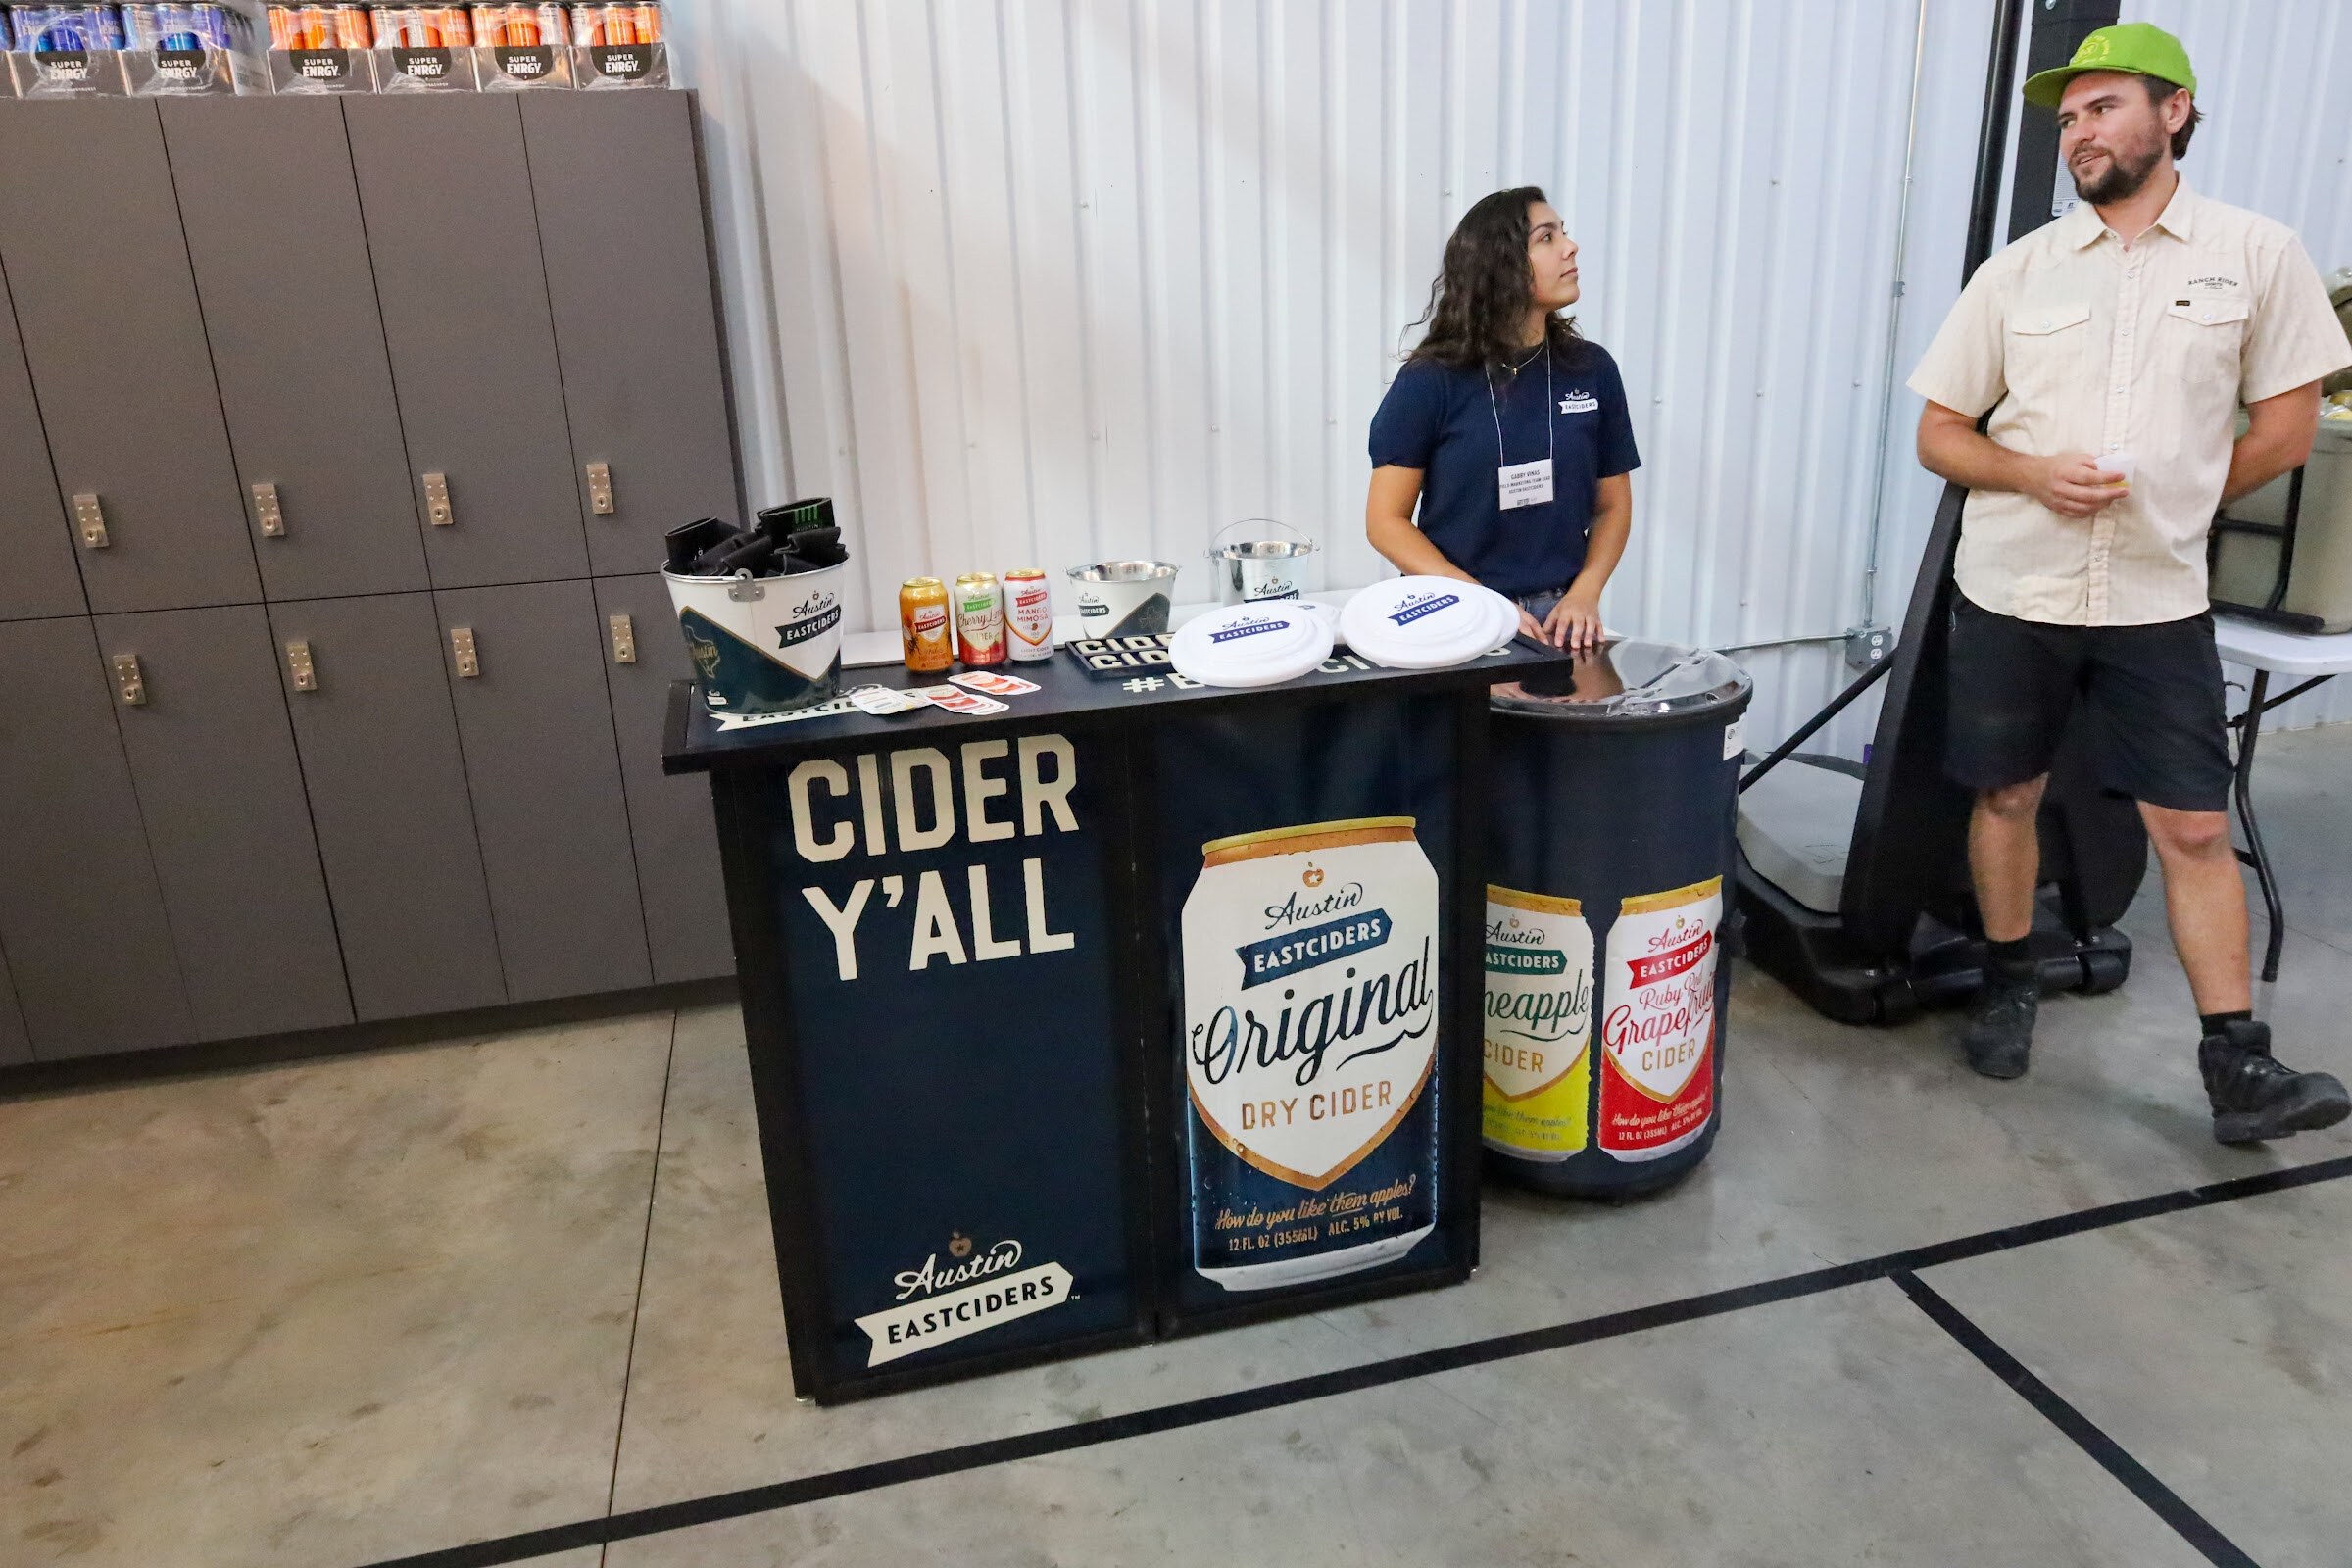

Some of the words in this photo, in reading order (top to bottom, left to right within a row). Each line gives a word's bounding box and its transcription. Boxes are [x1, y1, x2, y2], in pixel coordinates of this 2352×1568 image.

[51, 60, 82, 69] SUPER
[161, 59, 192, 68] SUPER
[407, 63, 443, 76] ENRGY
[507, 62, 542, 74] ENRGY
[508, 55, 537, 64] SUPER
[605, 60, 639, 74] ENRGY
[606, 53, 634, 62] SUPER
[302, 65, 339, 77] ENRGY
[1565, 391, 1590, 400] Austin
[1254, 581, 1292, 596] Austin
[792, 592, 835, 619] Austin
[1017, 607, 1048, 615] MANGO
[1394, 592, 1436, 612] Austin
[1399, 596, 1455, 622] EASTCIDERS
[786, 608, 839, 641] EASTCIDERS
[1219, 622, 1284, 640] EASTCIDERS
[1222, 617, 1269, 630] Austin
[788, 734, 1079, 863] CIDER
[1264, 882, 1363, 930] Austin
[801, 858, 1075, 981] Y'ALL
[1254, 918, 1382, 973] EASTCIDERS
[1484, 921, 1545, 945] Austin
[1648, 919, 1703, 953] Austin
[1485, 954, 1560, 969] ASTCIDERS
[1641, 938, 1708, 978] EASTCIDERS
[1484, 968, 1589, 1042] neapple
[1640, 986, 1682, 1010] Ruby
[1192, 936, 1434, 1087] Original
[1642, 1038, 1696, 1072] CIDER
[1242, 1097, 1298, 1130] DRY
[1309, 1080, 1392, 1121] CIDER
[1215, 1208, 1245, 1230] How
[1246, 1206, 1264, 1227] do
[1266, 1208, 1296, 1231] you
[1298, 1198, 1327, 1219] like
[1329, 1192, 1368, 1216] them
[1369, 1173, 1417, 1208] apples?
[1257, 1235, 1271, 1249] OZ
[1328, 1220, 1351, 1237] ALC.
[1353, 1215, 1371, 1231] 5%
[1373, 1210, 1386, 1224] BY
[1387, 1206, 1404, 1223] VOL.
[894, 1239, 1023, 1300] Austin
[888, 1276, 1054, 1344] EASTCIDERS
